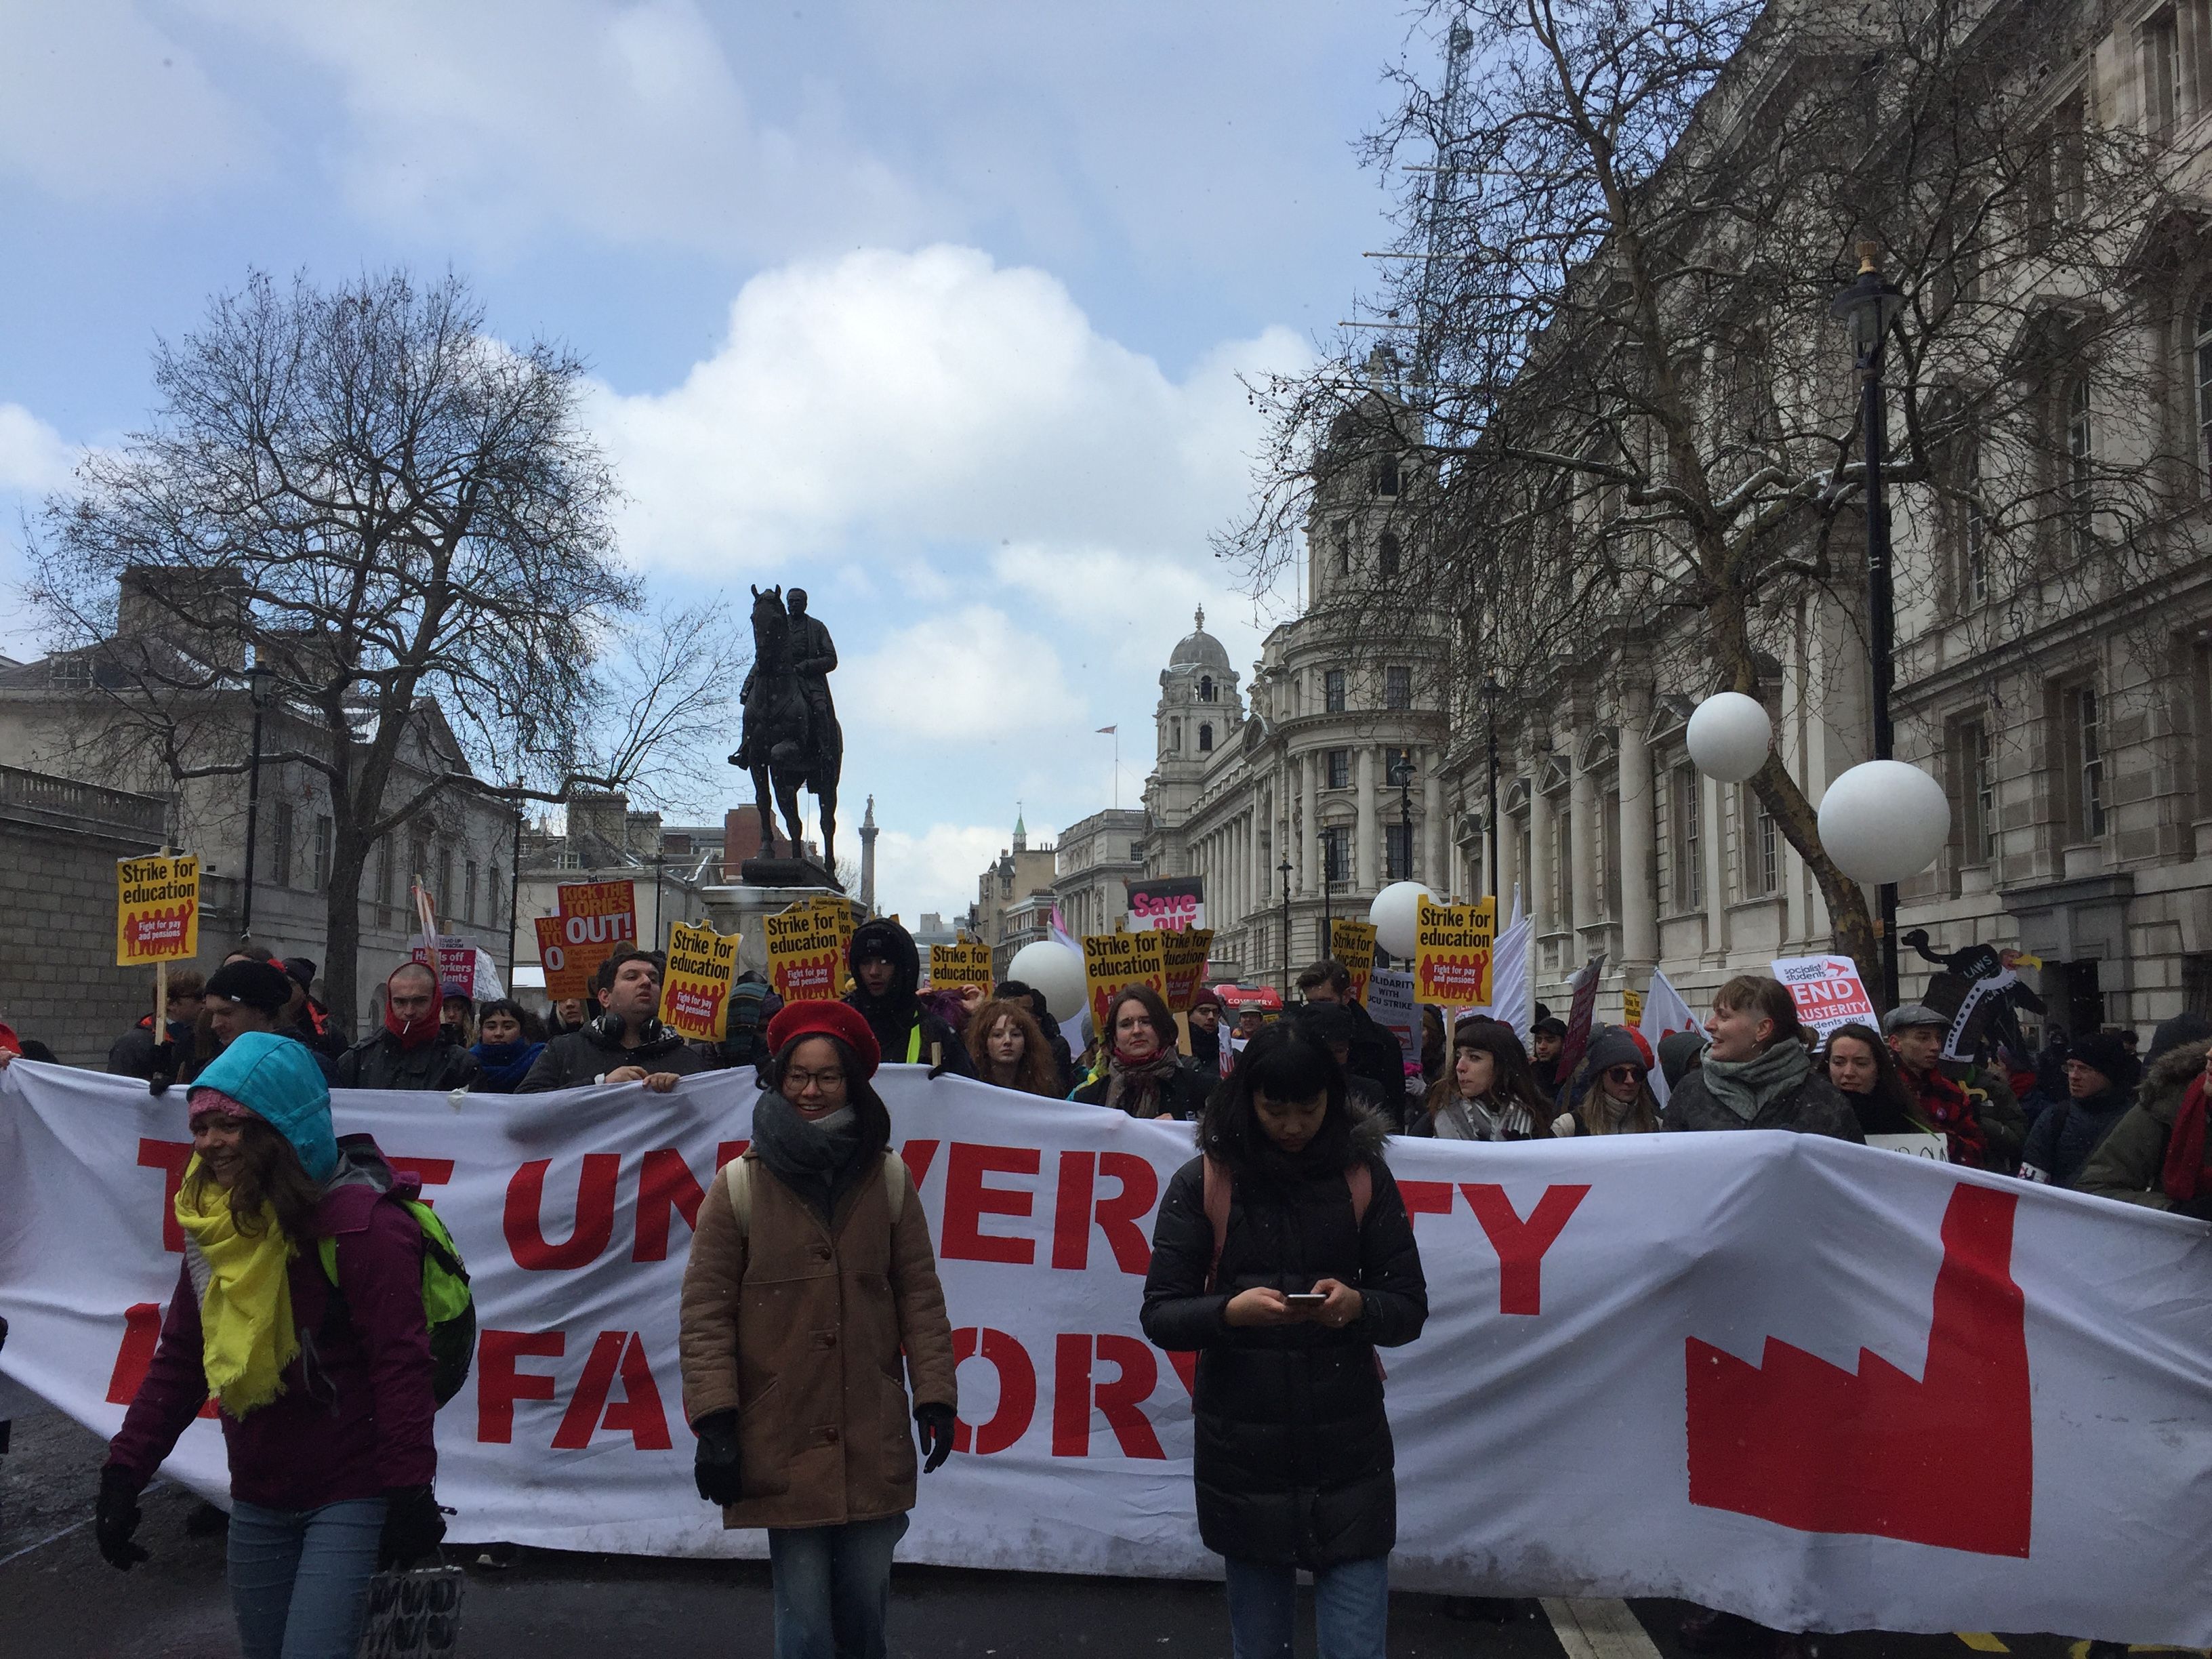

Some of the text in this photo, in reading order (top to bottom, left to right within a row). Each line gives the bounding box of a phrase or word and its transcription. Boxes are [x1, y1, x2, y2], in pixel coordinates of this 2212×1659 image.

[122, 859, 196, 884] Strike for
[123, 880, 195, 905] education
[562, 882, 630, 901] KICK THE
[563, 896, 630, 917] TORIES
[1133, 893, 1197, 918] Save
[138, 920, 181, 932] Fight for pay
[539, 918, 561, 932] KIC
[767, 915, 809, 936] Strike
[813, 913, 835, 930] for
[1420, 907, 1491, 928] Strike for
[138, 929, 181, 941] and pensions
[566, 912, 632, 944] OUT!
[673, 929, 733, 959] Strike for
[770, 932, 838, 954] education
[1086, 933, 1158, 957] Strike for
[1192, 932, 1210, 948] for
[1333, 931, 1372, 951] Strike for
[1420, 928, 1490, 948] education
[415, 951, 464, 962] Has off
[933, 945, 989, 964] Strike for
[1164, 949, 1205, 966] ducation
[441, 962, 472, 972] orkers
[670, 952, 730, 980] education
[787, 968, 827, 979] Fight for pay
[933, 964, 989, 981] education
[1089, 955, 1161, 977] education
[1433, 964, 1475, 977] Fight for pay
[1784, 964, 1822, 976] socialist
[1963, 955, 1992, 979] LAWS
[788, 977, 829, 987] and pensions
[1370, 975, 1415, 989] OLIDARITY
[1433, 975, 1475, 985] and pensions
[1786, 970, 1826, 981] students
[677, 991, 712, 1009] Fight for pay
[1378, 987, 1399, 998] WITH
[1792, 979, 1853, 1005] END
[676, 1002, 711, 1017] and pensions
[1368, 995, 1412, 1010] UCU STRIKE
[1797, 1001, 1866, 1021] AUSTERITY
[1845, 1015, 1866, 1025] and
